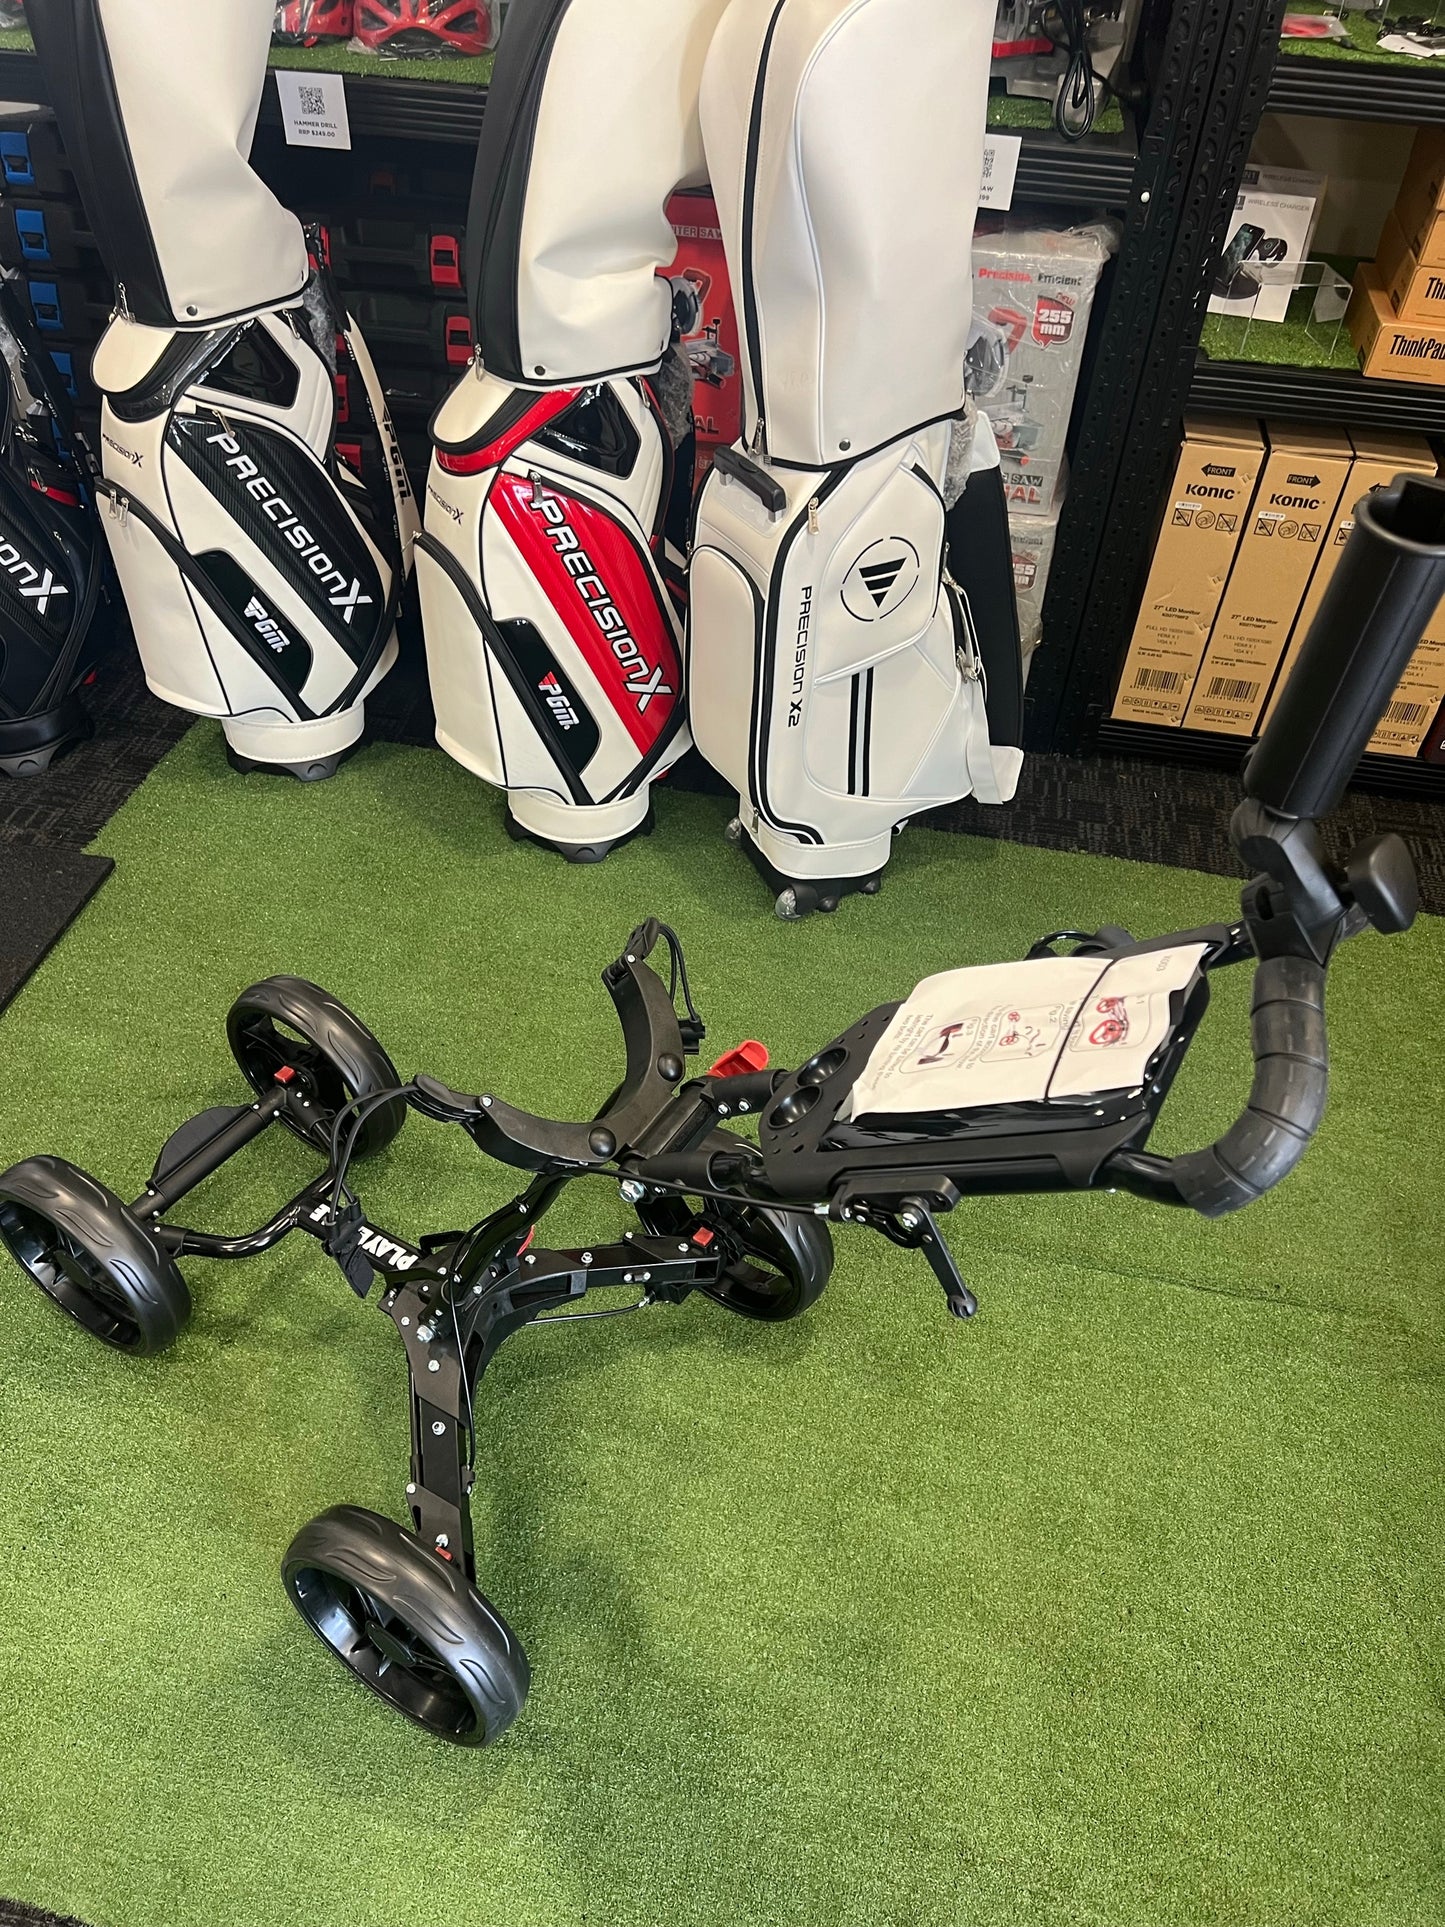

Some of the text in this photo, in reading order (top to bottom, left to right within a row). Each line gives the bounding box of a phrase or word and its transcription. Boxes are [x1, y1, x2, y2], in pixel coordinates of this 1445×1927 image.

[293, 120, 338, 129] HAMMER DRILL
[1247, 199, 1279, 208] WIRELESS
[1280, 202, 1310, 211] CHARGER
[1038, 309, 1072, 324] 255
[1040, 324, 1065, 336] mm
[1206, 466, 1233, 476] FRONT
[1012, 474, 1042, 486] SAW
[1288, 475, 1313, 485] FRONT
[1012, 563, 1036, 576] 55
[788, 699, 803, 728] X2
